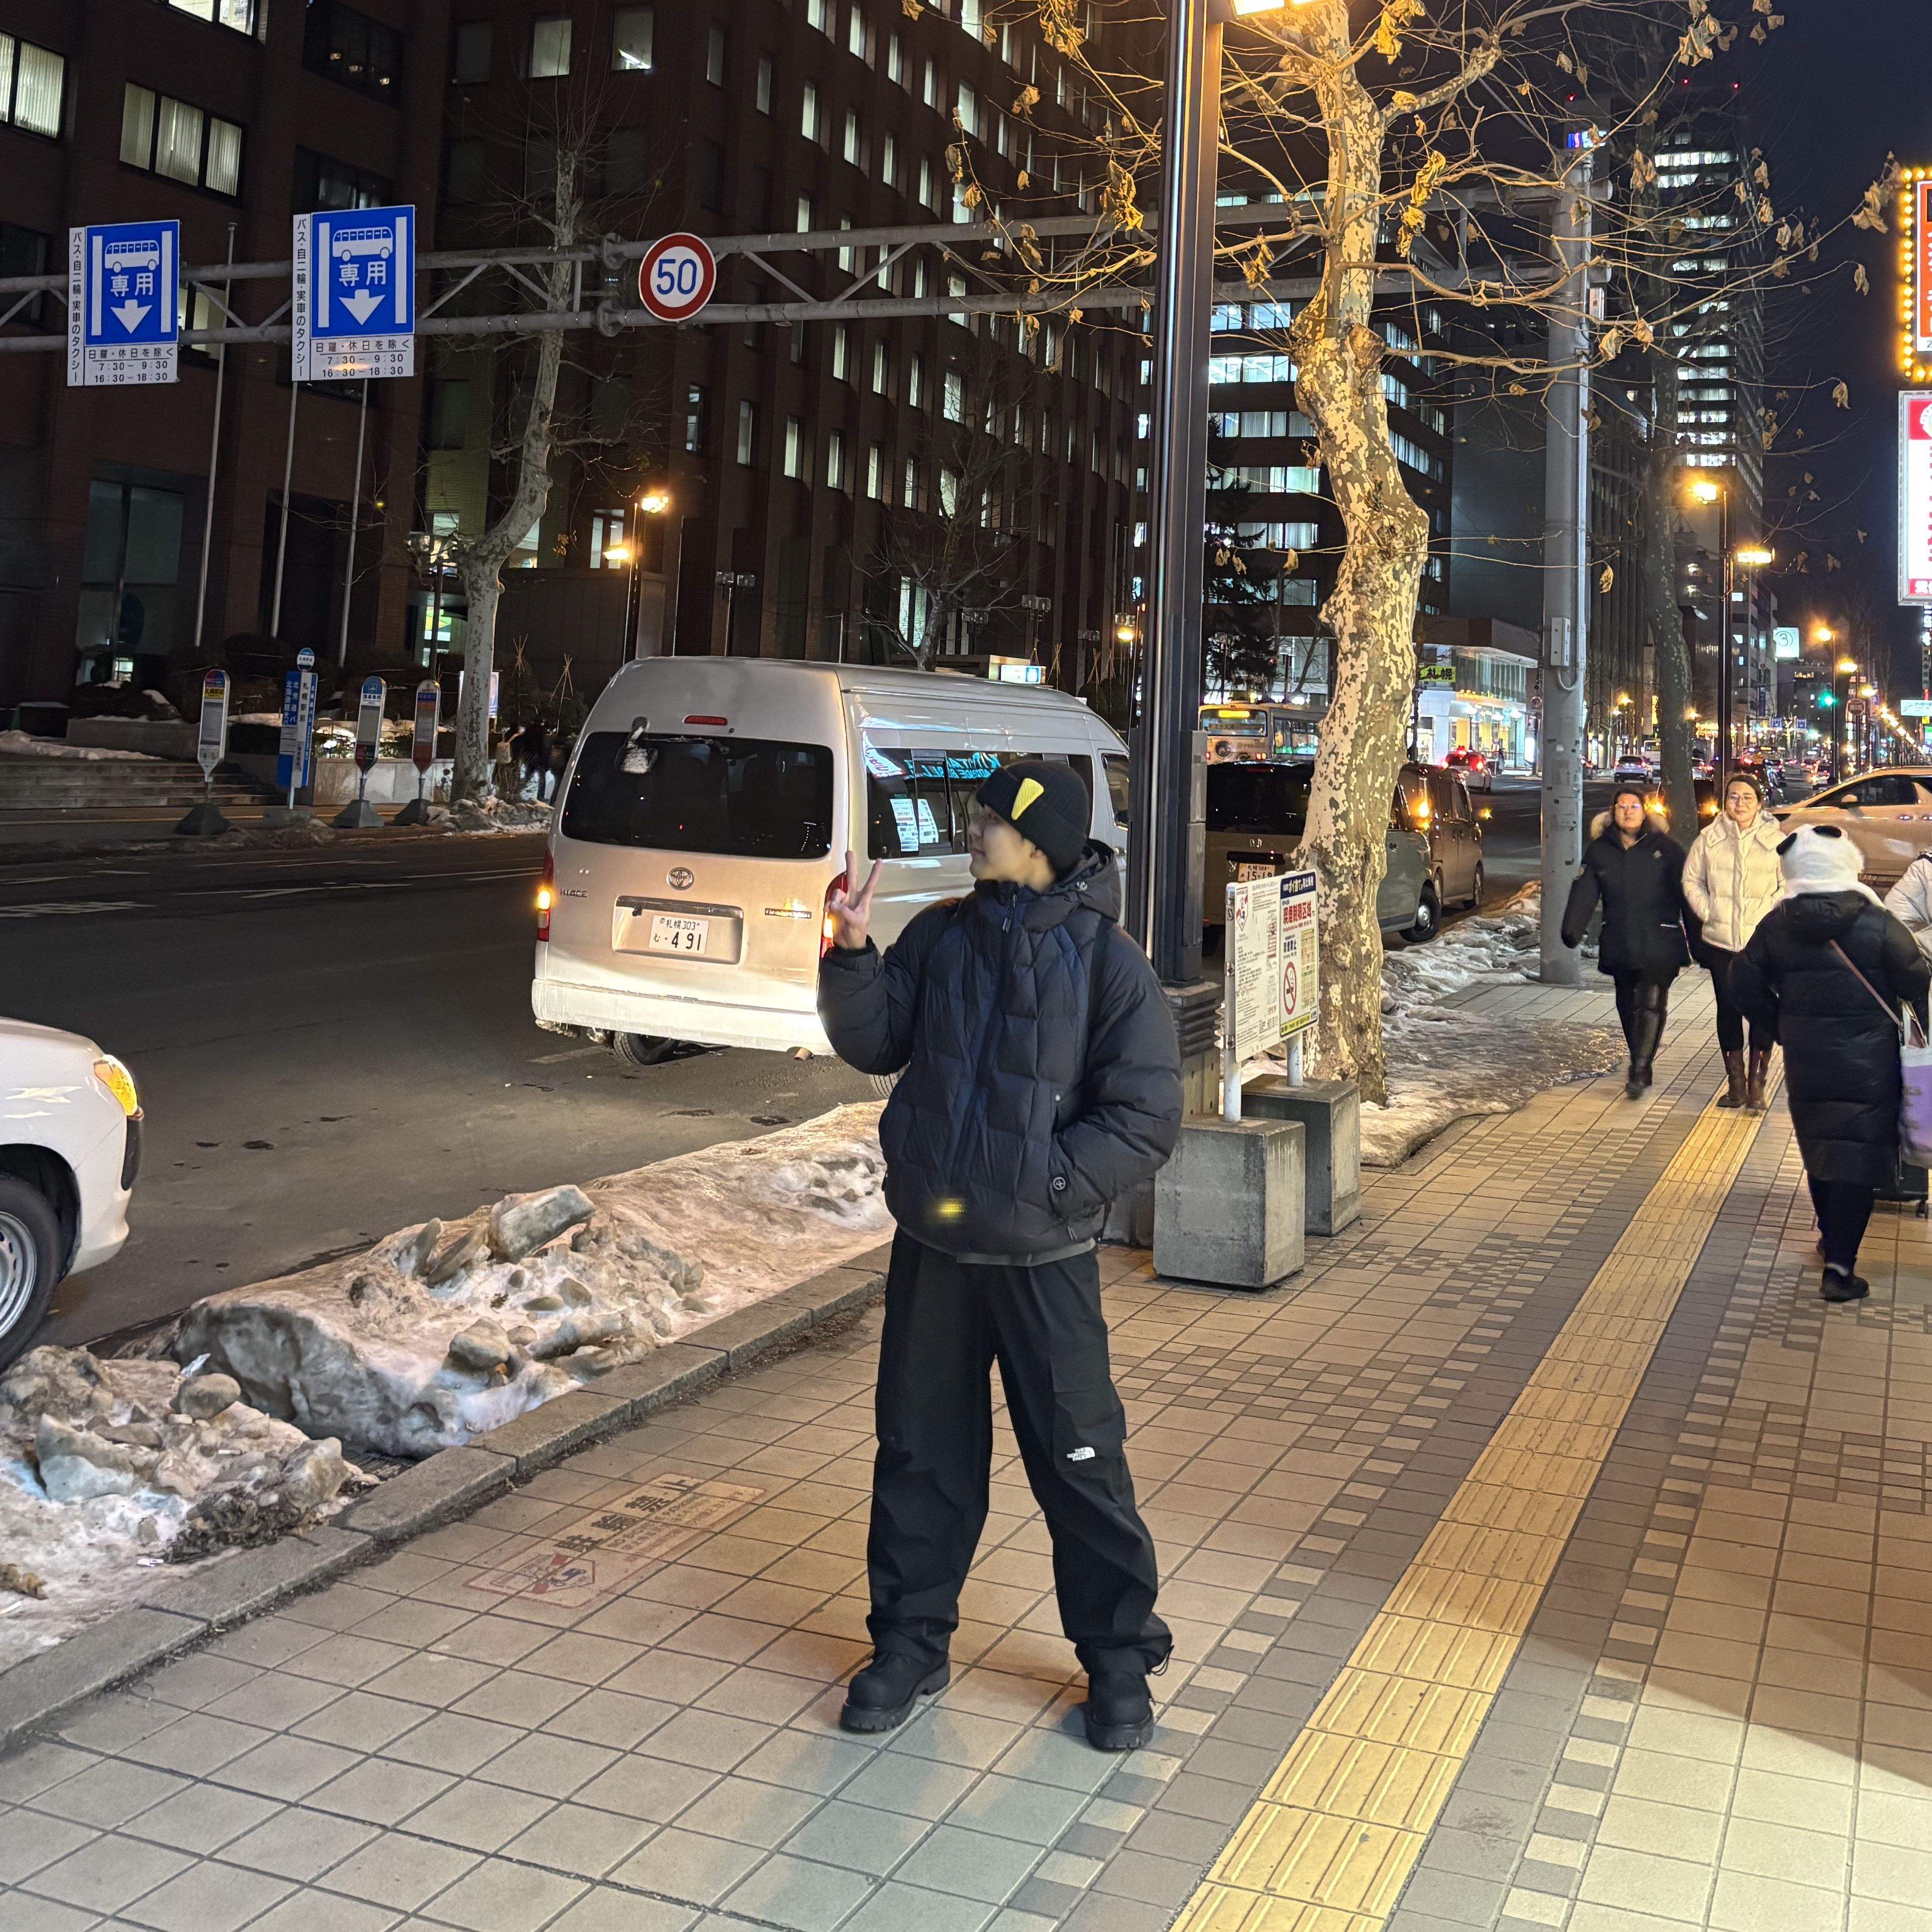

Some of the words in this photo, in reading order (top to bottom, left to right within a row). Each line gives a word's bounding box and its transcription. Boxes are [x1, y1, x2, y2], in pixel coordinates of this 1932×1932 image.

[110, 272, 153, 297] 専用
[339, 261, 387, 287] 専用
[656, 258, 697, 295] 50
[1427, 667, 1452, 680] 札幌
